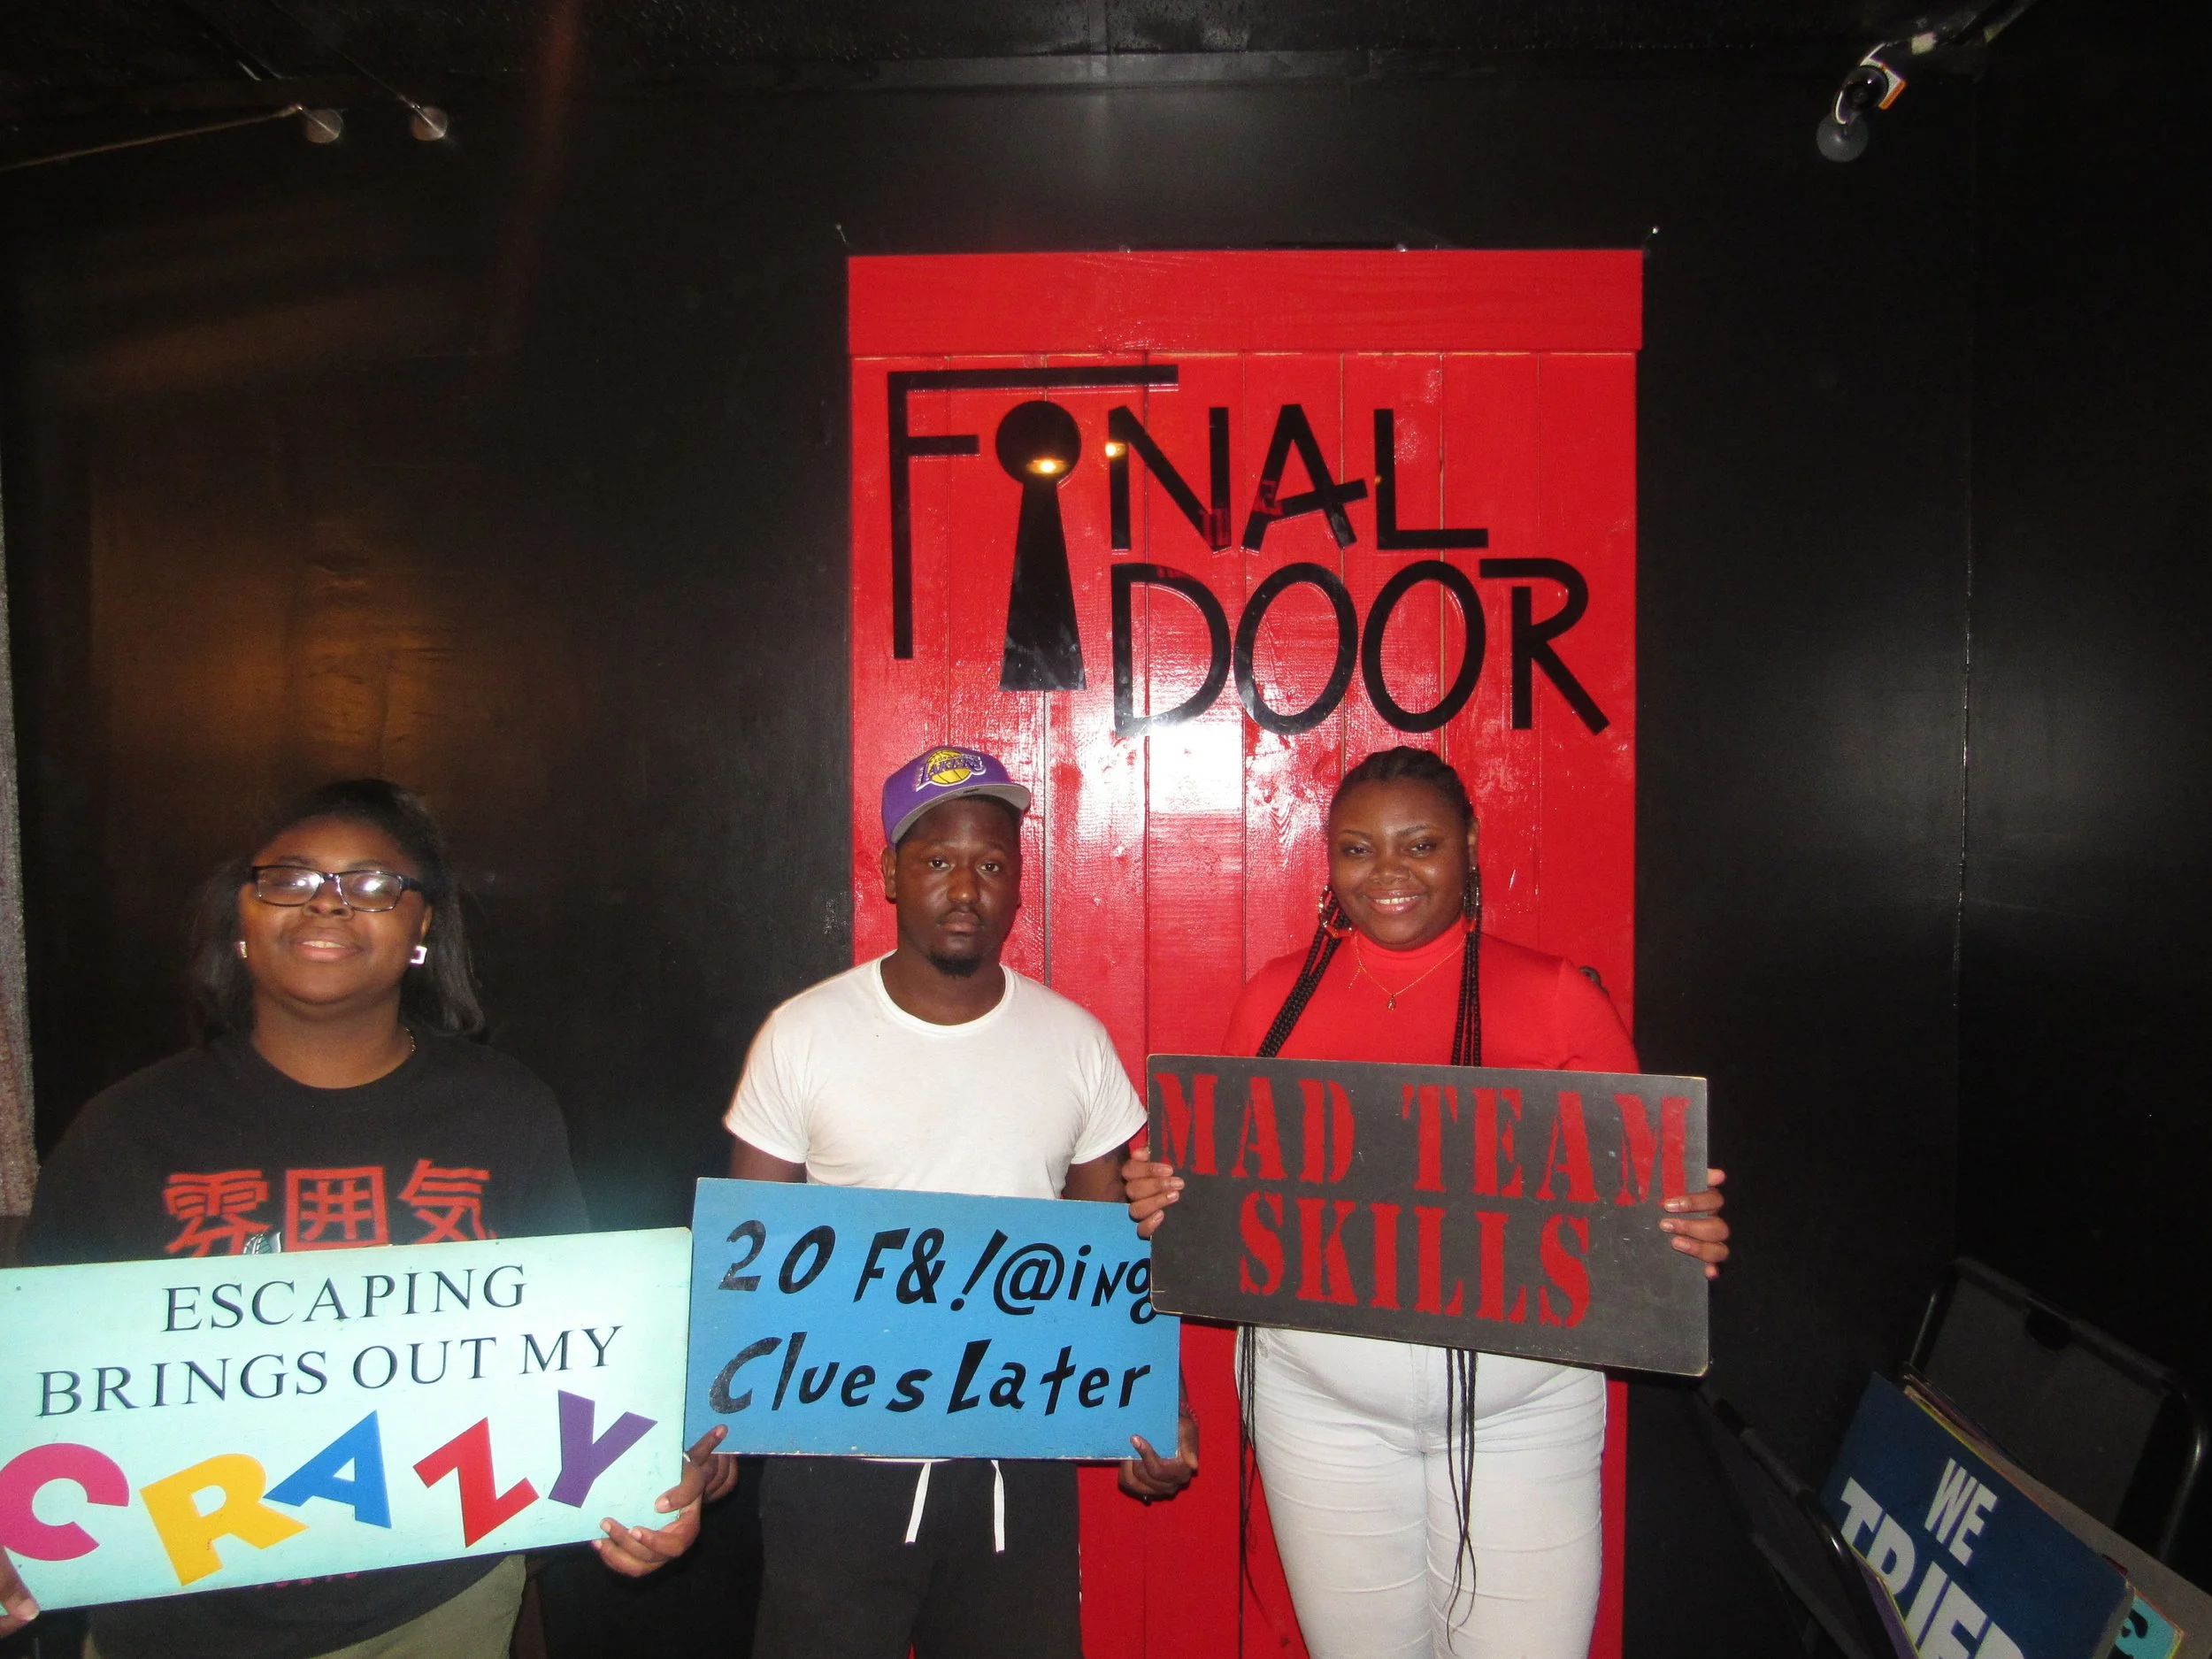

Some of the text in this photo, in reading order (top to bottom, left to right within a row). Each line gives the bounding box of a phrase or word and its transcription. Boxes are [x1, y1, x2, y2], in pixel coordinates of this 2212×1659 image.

[1111, 558, 1611, 736] DOOR
[1155, 1072, 1690, 1207] MAD TEAM
[164, 1264, 529, 1333] ESCAPING
[718, 1219, 836, 1294] 20
[1240, 1191, 1591, 1328] SKILLS
[36, 1325, 623, 1417] BRINGS OUT MY
[709, 1331, 1151, 1416] Clues Later
[0, 1390, 658, 1586] CRAZY
[1924, 1457, 1999, 1567] WE
